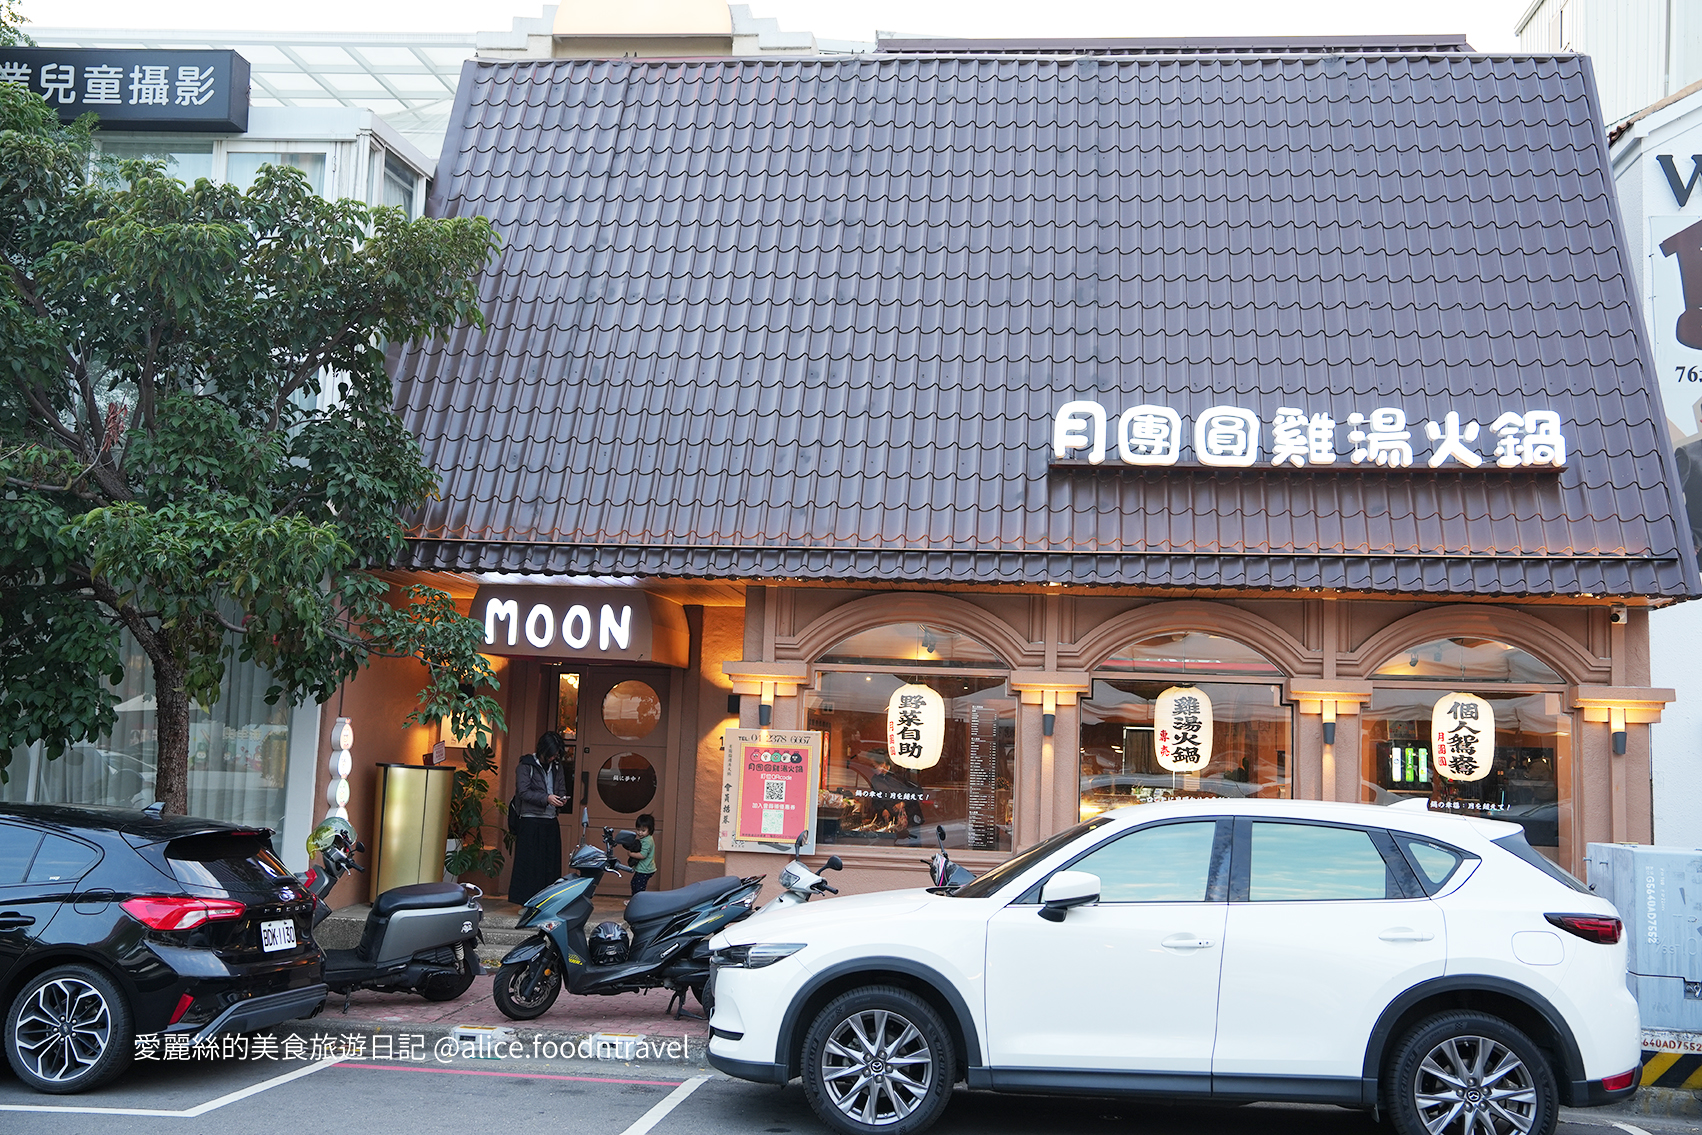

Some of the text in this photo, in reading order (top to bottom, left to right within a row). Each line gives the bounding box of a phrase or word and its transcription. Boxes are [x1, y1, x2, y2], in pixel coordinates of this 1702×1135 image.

[1675, 365, 1702, 383] 76
[1053, 400, 1567, 468] 月團圓雞湯火鍋
[484, 597, 632, 651] MOON
[790, 735, 811, 745] 6667
[897, 694, 927, 759] 野菜自助
[1171, 696, 1203, 764] 雞湯火鍋
[1446, 701, 1481, 776] 個人鴛鴦
[1642, 1038, 1702, 1052] 640AD7552
